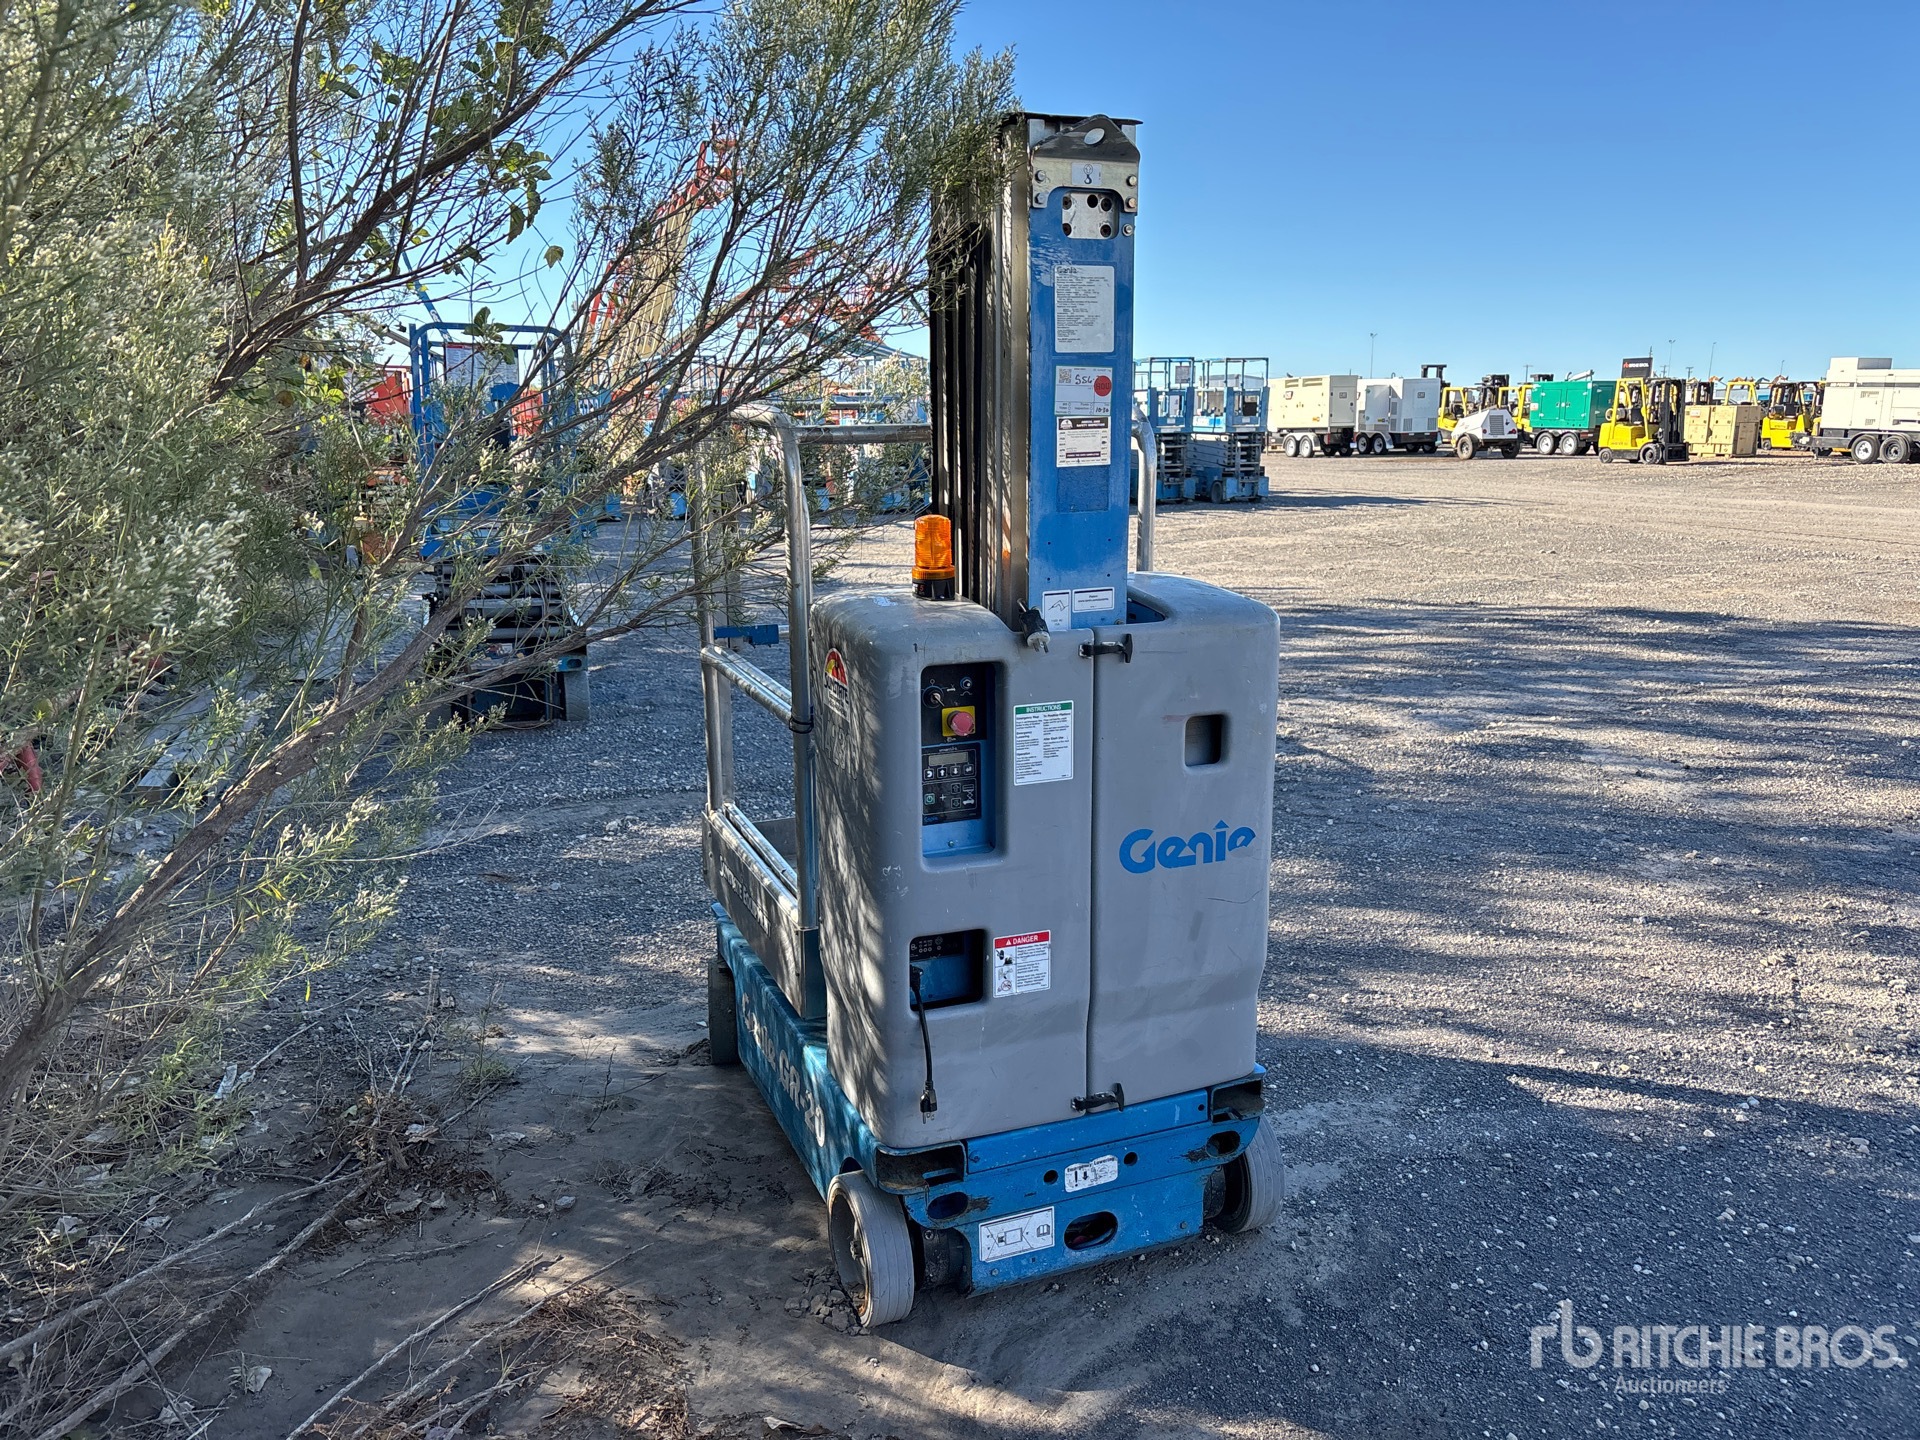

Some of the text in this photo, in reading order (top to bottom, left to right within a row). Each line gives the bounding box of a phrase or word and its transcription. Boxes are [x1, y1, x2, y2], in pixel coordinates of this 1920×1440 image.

[1026, 704, 1061, 712] INSTRUCTIONS
[1119, 820, 1256, 874] Genie
[1012, 934, 1039, 945] DANGER
[778, 1049, 826, 1148] GR-20
